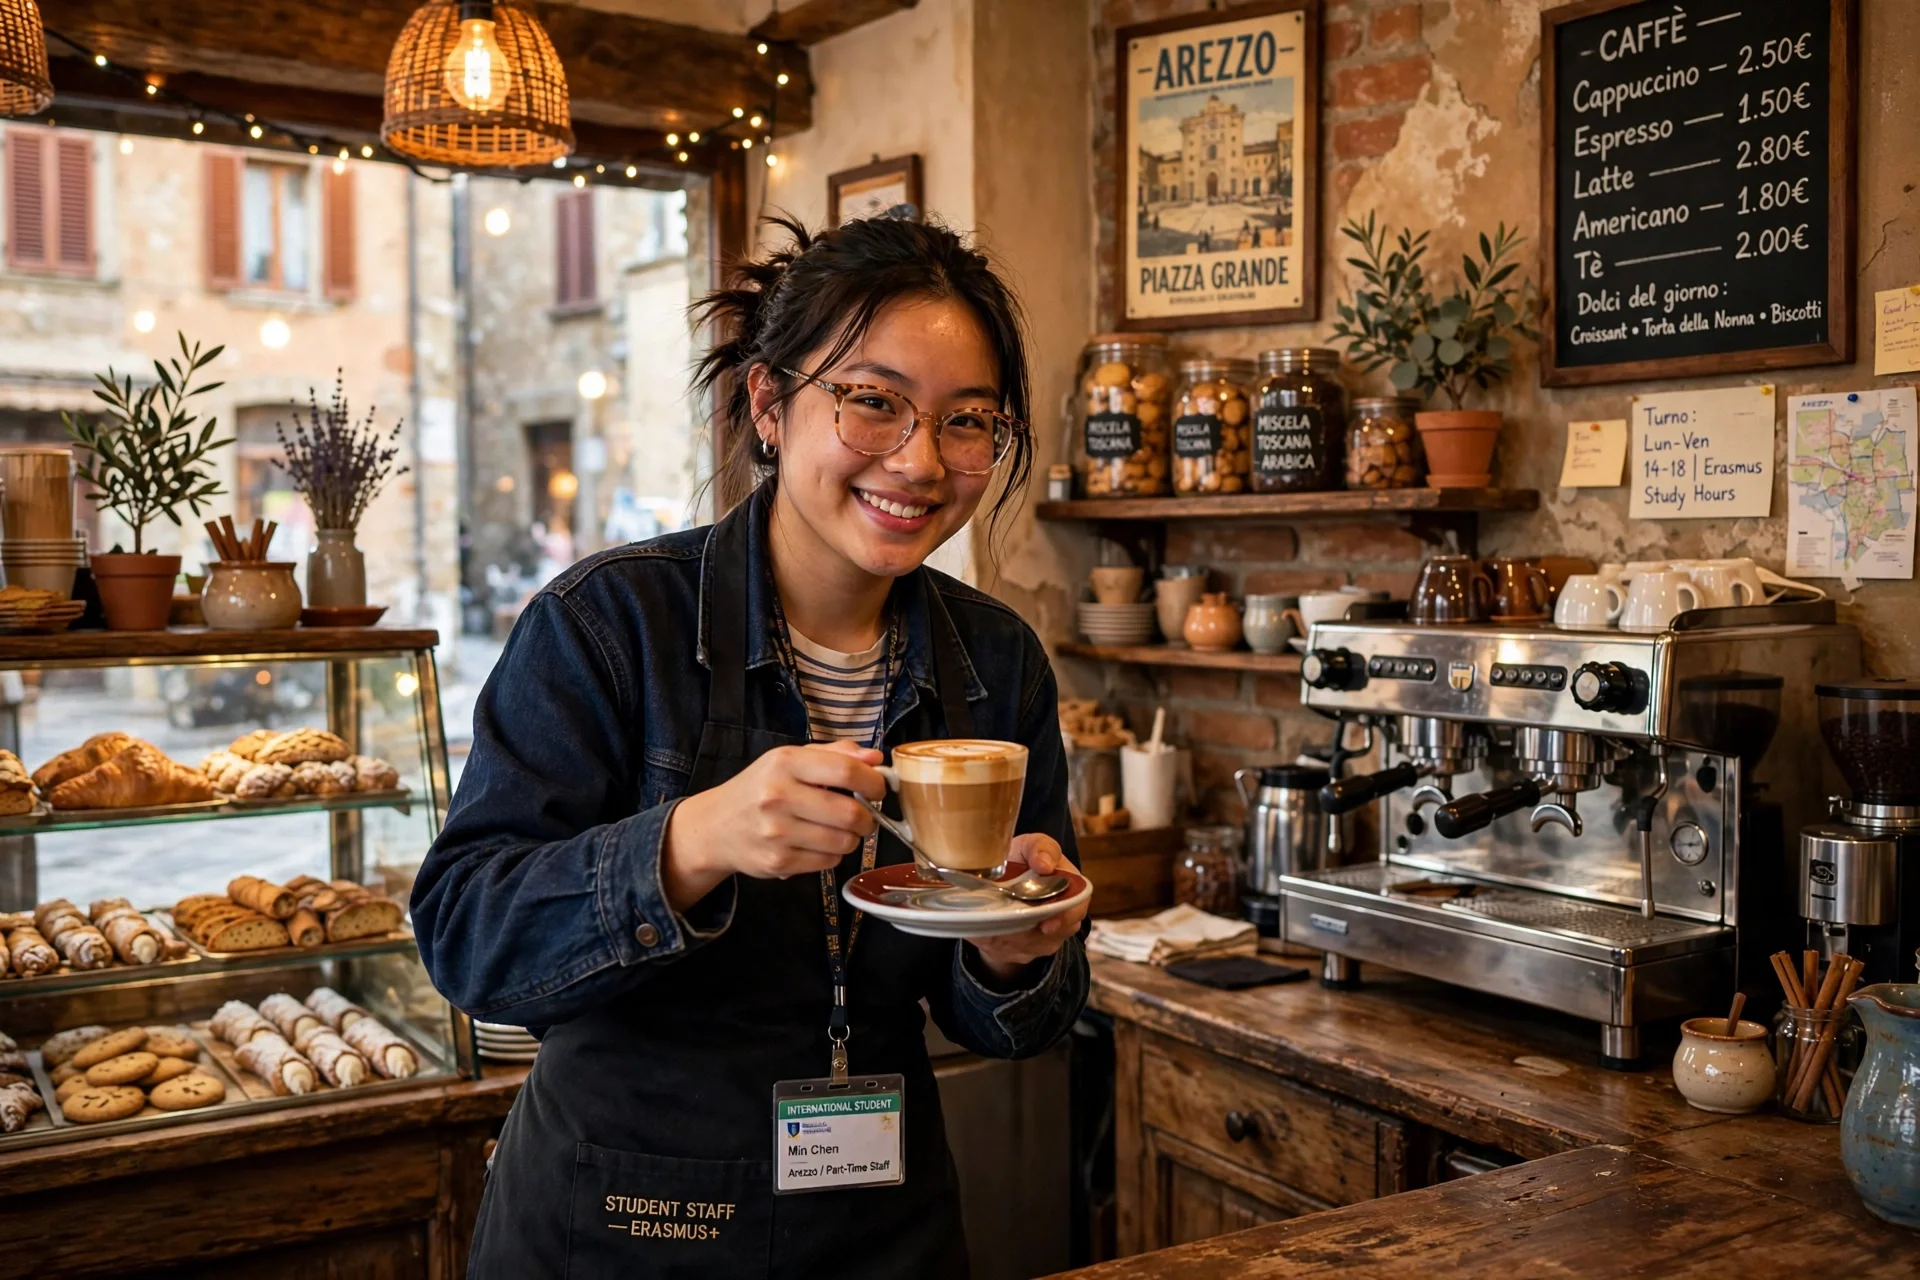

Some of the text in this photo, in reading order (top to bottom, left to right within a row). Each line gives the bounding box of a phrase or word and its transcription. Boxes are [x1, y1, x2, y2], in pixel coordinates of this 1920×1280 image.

[1600, 6, 1687, 62] CAFFÈ
[1153, 29, 1277, 91] AREZZO
[1573, 32, 1812, 118] Cappuccino 2.50€
[1574, 82, 1811, 162] Espresso 1.50€
[1574, 130, 1810, 200] Latte 2.80€
[1572, 177, 1810, 243] Americano 1.80€
[1573, 223, 1810, 280] Tè 2.00€
[1140, 255, 1289, 295] PIAZZA GRANDE
[1577, 290, 1621, 316] Dolci
[1628, 282, 1657, 308] del
[1571, 301, 1822, 346] Croissant Torta della Nonna Biscotti
[1088, 420, 1131, 435] MISCELA
[1257, 414, 1311, 431] MISCELA
[1088, 436, 1133, 450] TOSCANA
[1257, 434, 1312, 451] TOSCANA
[1644, 431, 1709, 453] Lun-Ven
[1261, 453, 1315, 471] ARABICA
[1644, 459, 1686, 478] 14-18
[1704, 458, 1763, 476] Erasmus
[1644, 485, 1736, 511] Study Hours
[787, 1099, 892, 1115] INTERNATIONAL STUDENT
[788, 1144, 839, 1156] Min Chen
[826, 1162, 868, 1175] Part-Time
[870, 1159, 890, 1171] Staff
[605, 1195, 736, 1220] STUDENT STAFF
[631, 1219, 720, 1240] ERASMUS+
